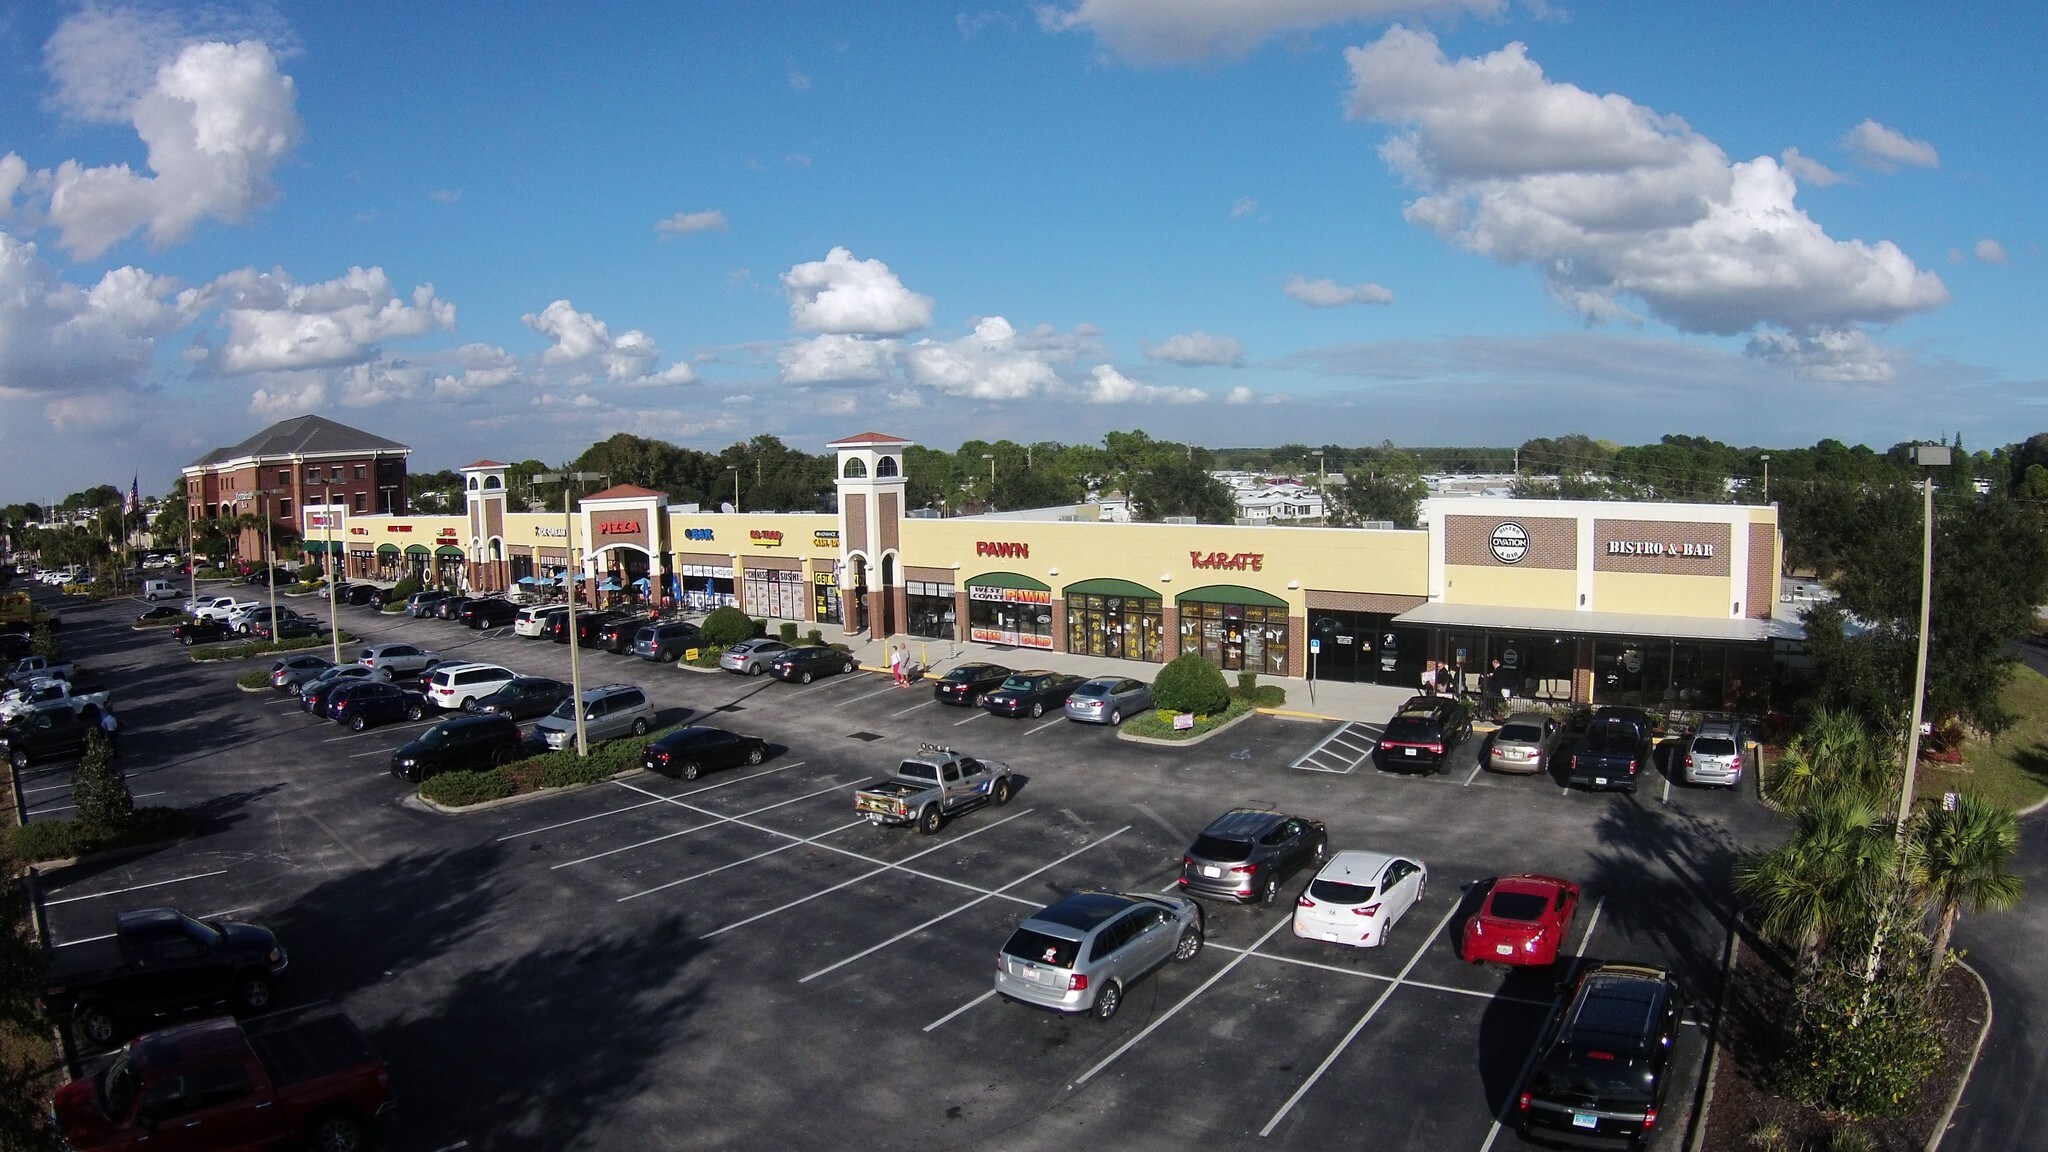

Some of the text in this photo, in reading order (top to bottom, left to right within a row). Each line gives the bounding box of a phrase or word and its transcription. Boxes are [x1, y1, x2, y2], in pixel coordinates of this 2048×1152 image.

[598, 521, 641, 534] PIZZA
[1499, 526, 1520, 534] BISTRO
[692, 529, 714, 540] BAR
[1492, 537, 1527, 547] OVATION
[976, 541, 1029, 559] PAWN
[1608, 541, 1714, 557] BISTRO & BAR
[1189, 551, 1264, 572] KARATE
[748, 570, 799, 582] CHINESE SUSHI
[816, 573, 829, 583] GET
[975, 586, 1000, 594] WEST
[1005, 589, 1050, 604] PAWN
[1007, 633, 1014, 644] 4
[1022, 635, 1051, 647] GOLD
